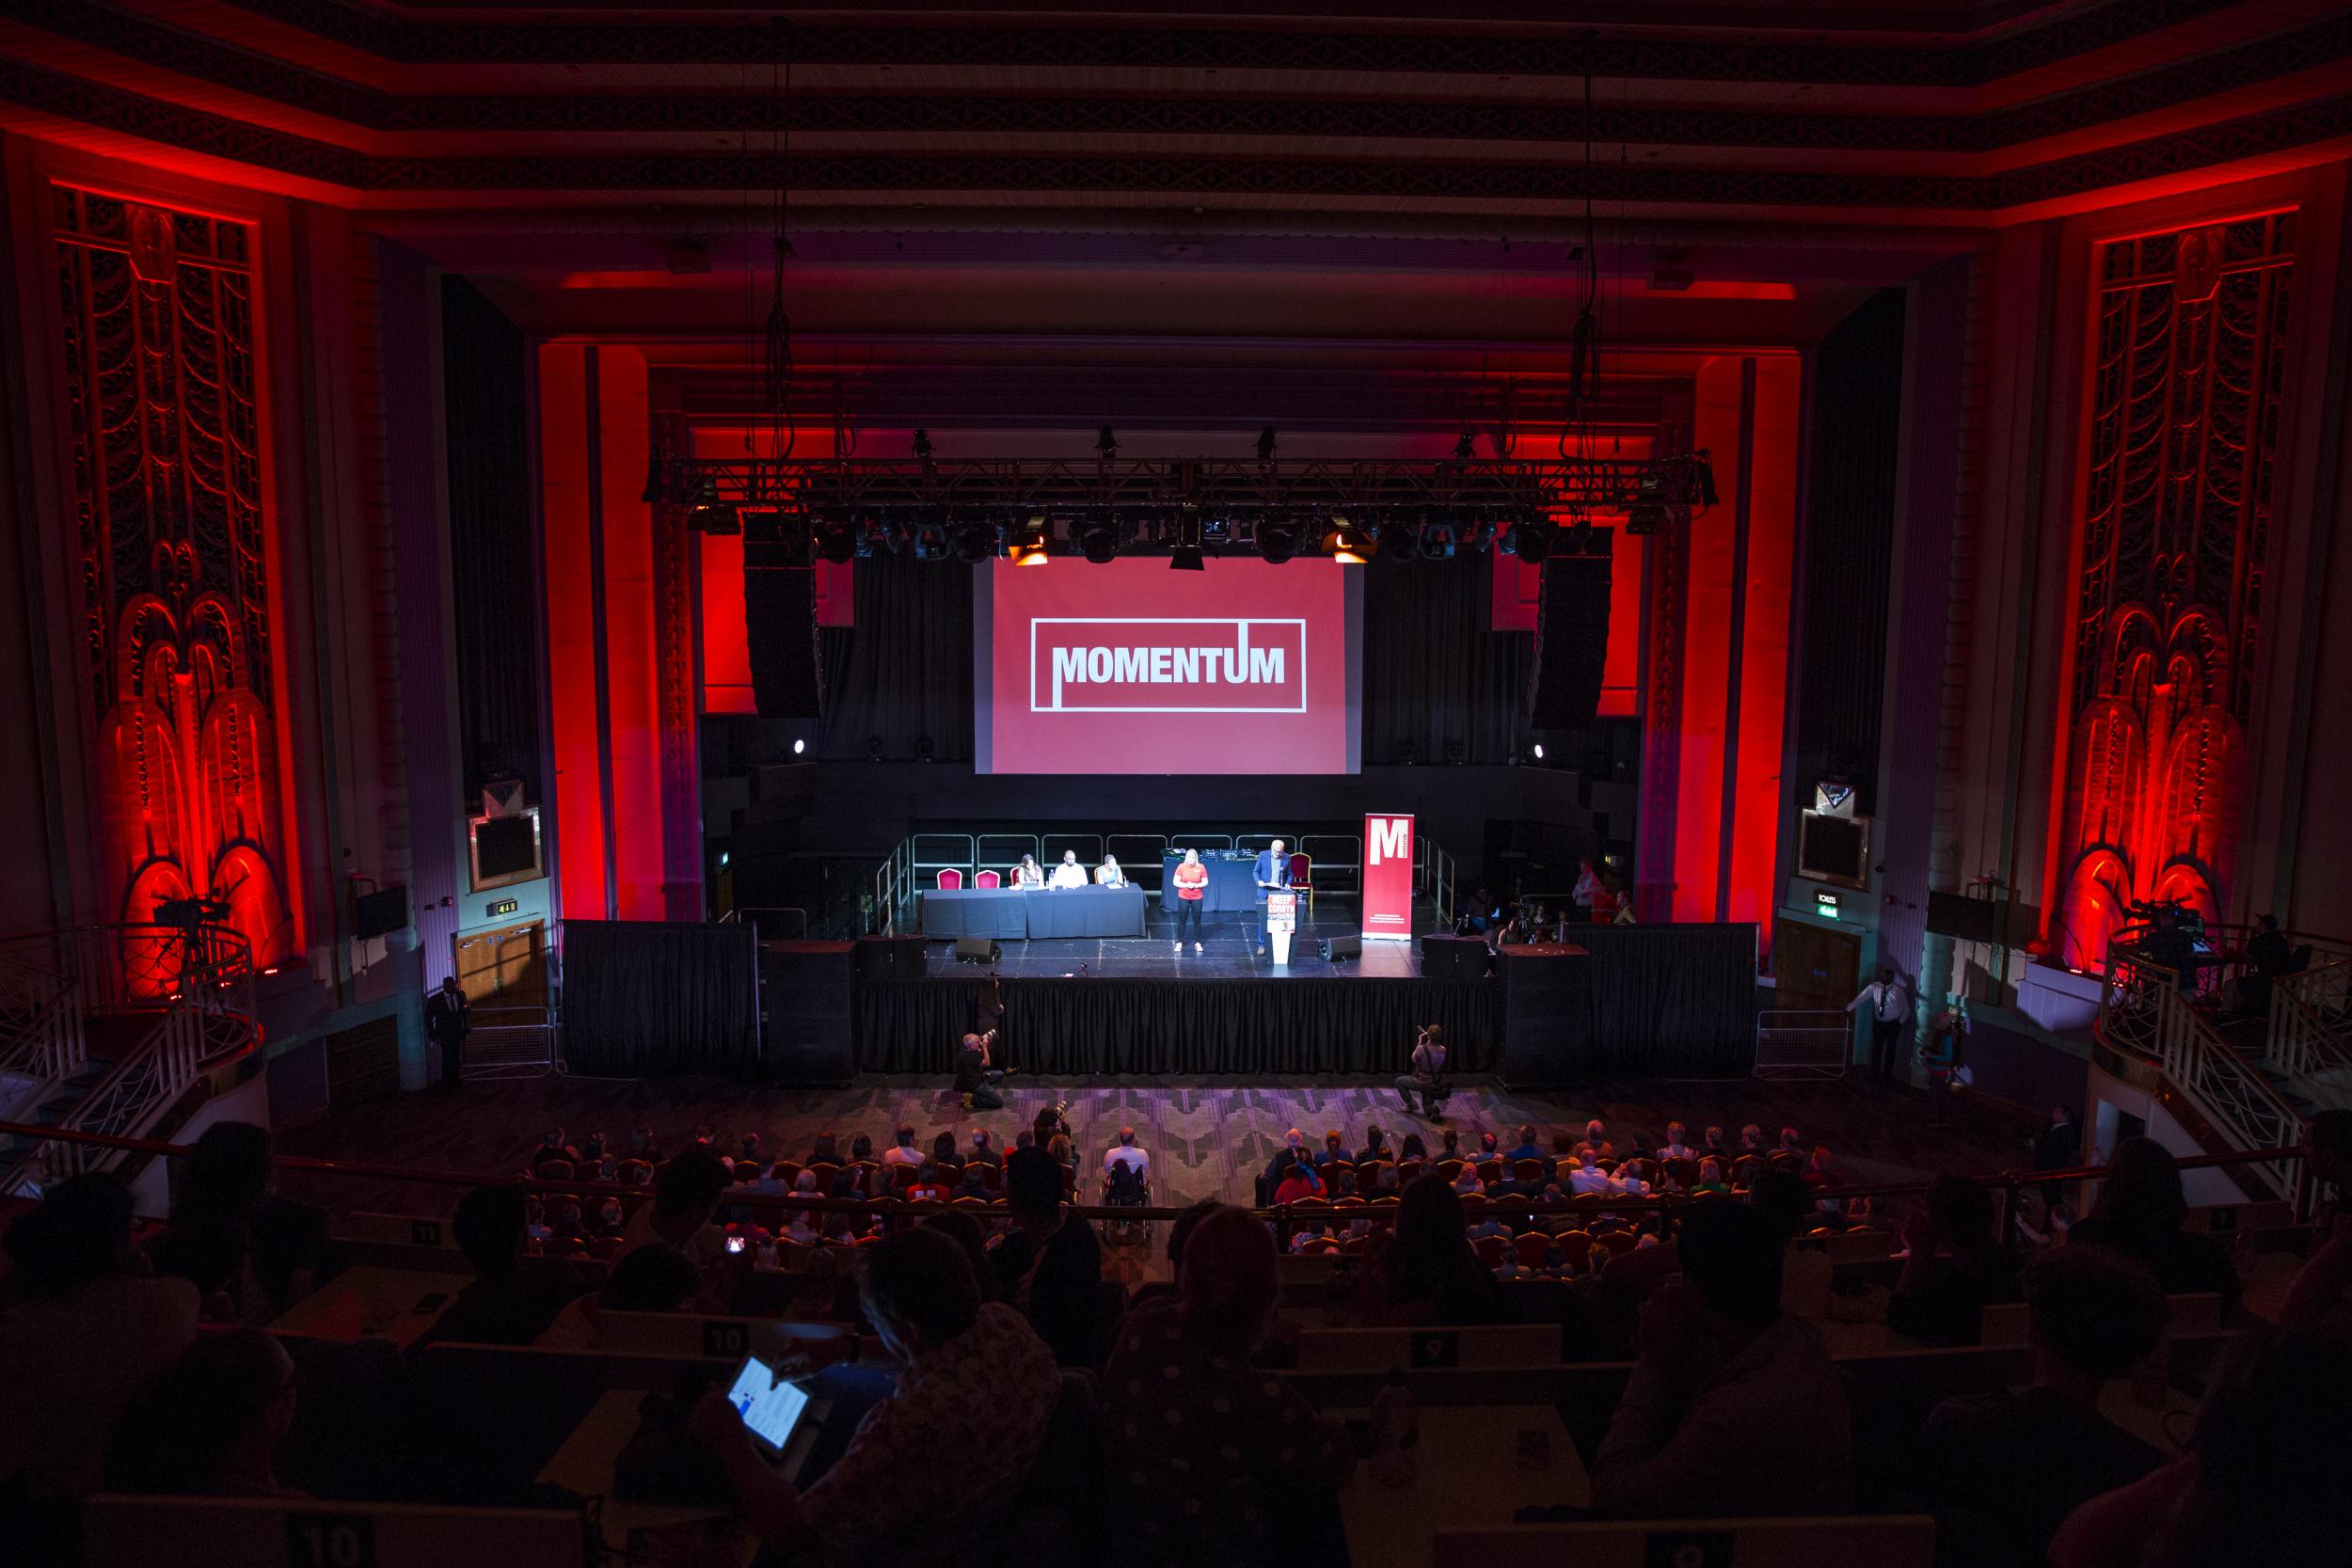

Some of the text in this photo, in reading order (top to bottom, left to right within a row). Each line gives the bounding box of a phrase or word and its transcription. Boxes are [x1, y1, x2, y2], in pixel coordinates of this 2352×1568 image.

[1370, 818, 1408, 865] M
[710, 1328, 741, 1352] 10
[1425, 1338, 1443, 1361] 9
[303, 1525, 359, 1568] 10
